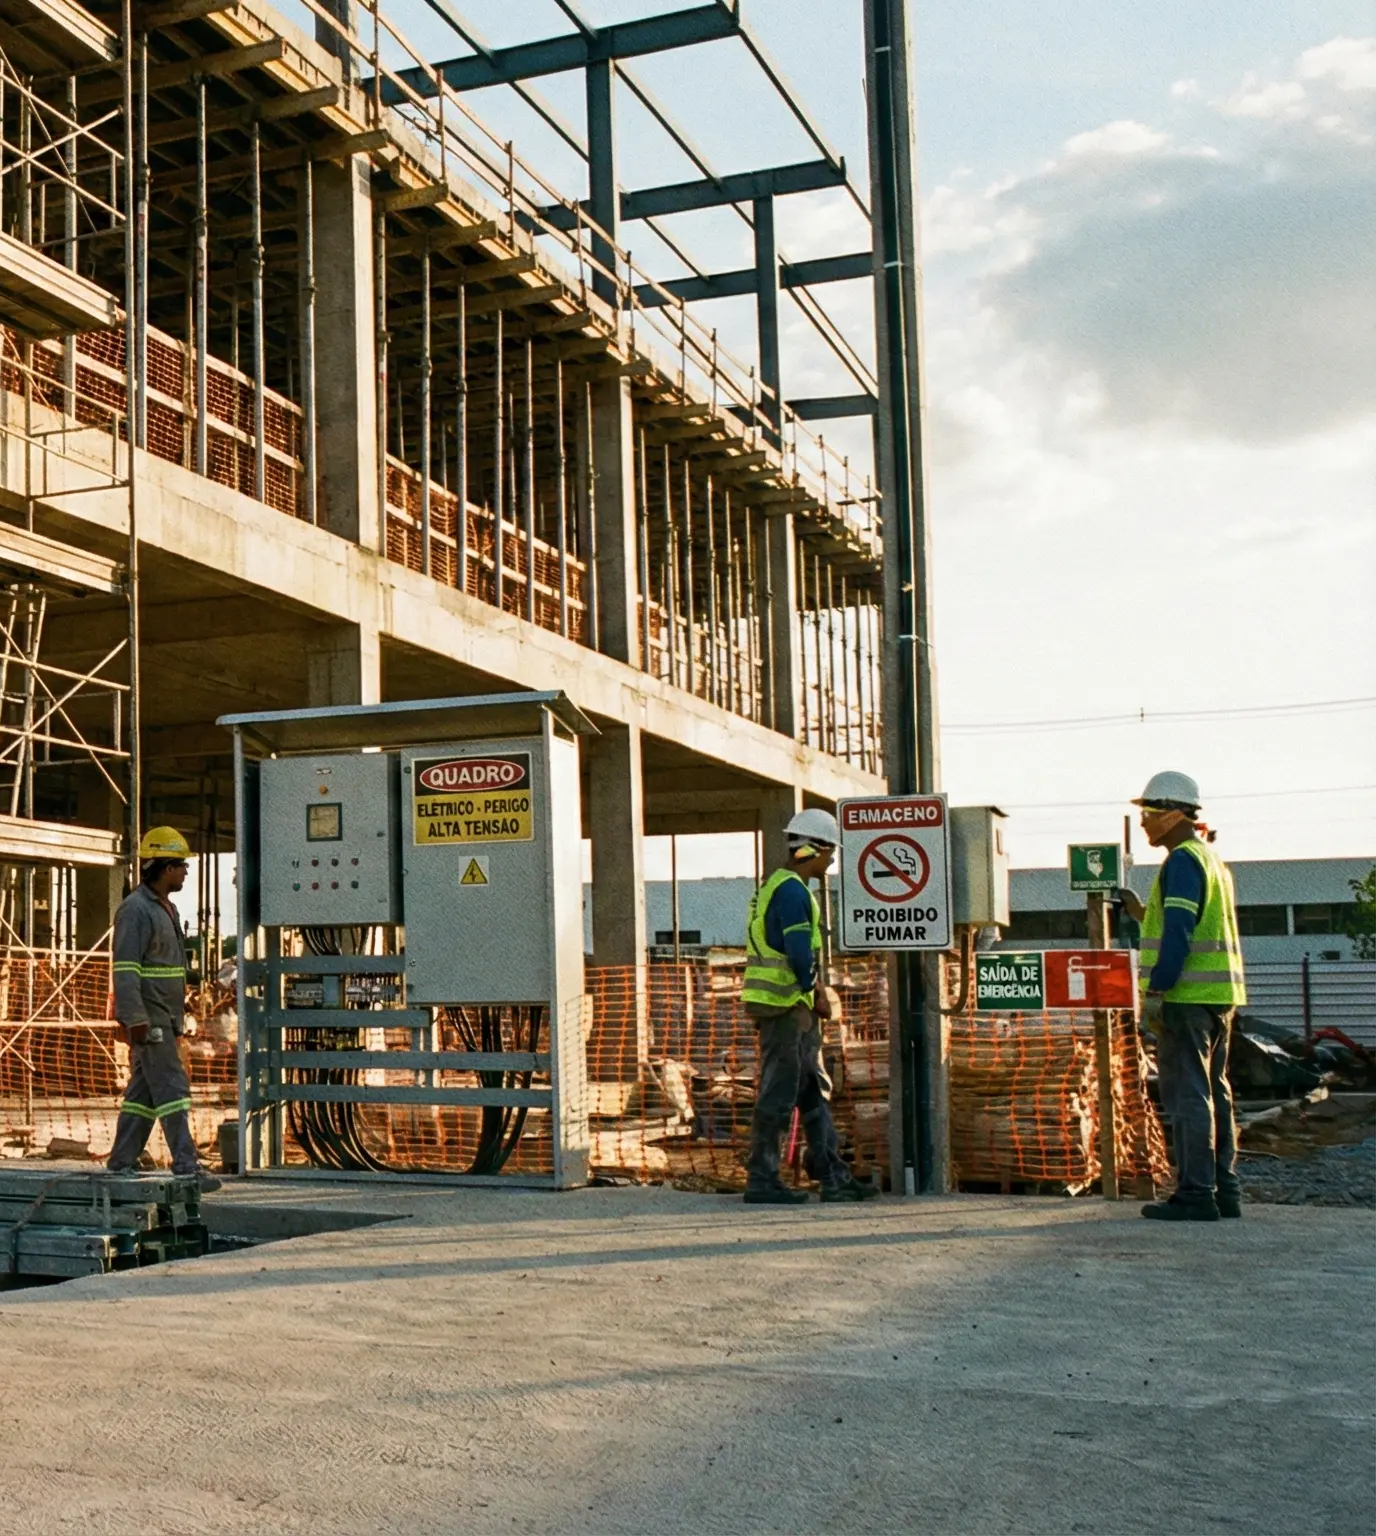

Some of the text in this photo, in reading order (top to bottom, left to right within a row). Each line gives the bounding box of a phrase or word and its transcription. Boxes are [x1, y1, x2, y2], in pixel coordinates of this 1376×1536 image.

[429, 764, 514, 786] QUADRO
[484, 797, 529, 814] PERIGO
[428, 821, 461, 837] ALTA
[853, 907, 938, 923] PROIBIDO
[865, 926, 926, 941] FUMAR
[979, 961, 1038, 982] SAÍDA DE
